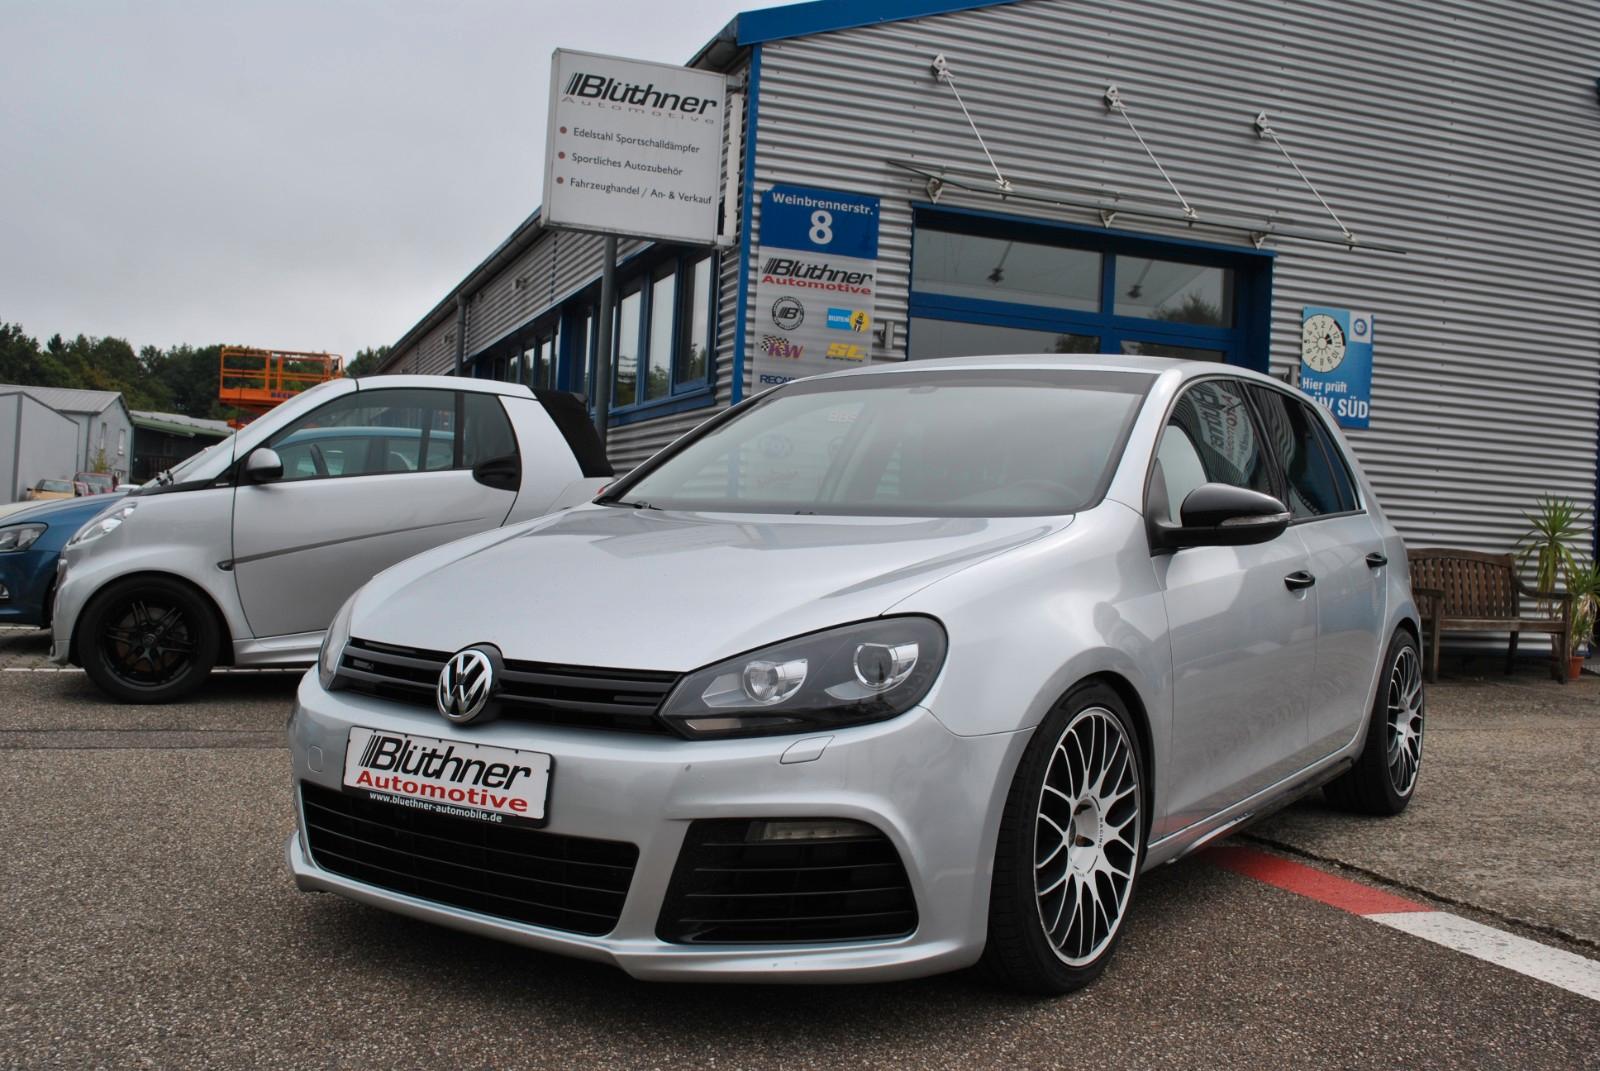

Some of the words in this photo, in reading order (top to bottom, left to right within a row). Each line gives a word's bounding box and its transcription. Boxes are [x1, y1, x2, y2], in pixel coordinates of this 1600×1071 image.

[567, 72, 717, 115] Blüthner
[562, 96, 714, 124] Automotive
[573, 127, 613, 142] Edelstahl
[616, 133, 700, 154] Sportschalldämpfer
[571, 153, 621, 168] Sportliches
[624, 160, 683, 176] Autozubehör
[570, 178, 640, 196] Fahrzeughandel
[650, 188, 666, 199] An-
[668, 190, 675, 200] &
[678, 192, 712, 205] Verkauf
[772, 192, 874, 215] Weinbrennerstr.
[808, 210, 833, 244] 8
[761, 275, 871, 295] Automotive
[762, 257, 873, 286] Blüthner
[767, 342, 804, 358] KW
[1302, 377, 1322, 389] Hier
[1325, 381, 1347, 394] prüft
[1337, 395, 1369, 418] SÜD
[358, 734, 532, 791] Blüthner
[356, 770, 528, 812] Automotive
[369, 791, 503, 823] www.bluethner-automobile.de
